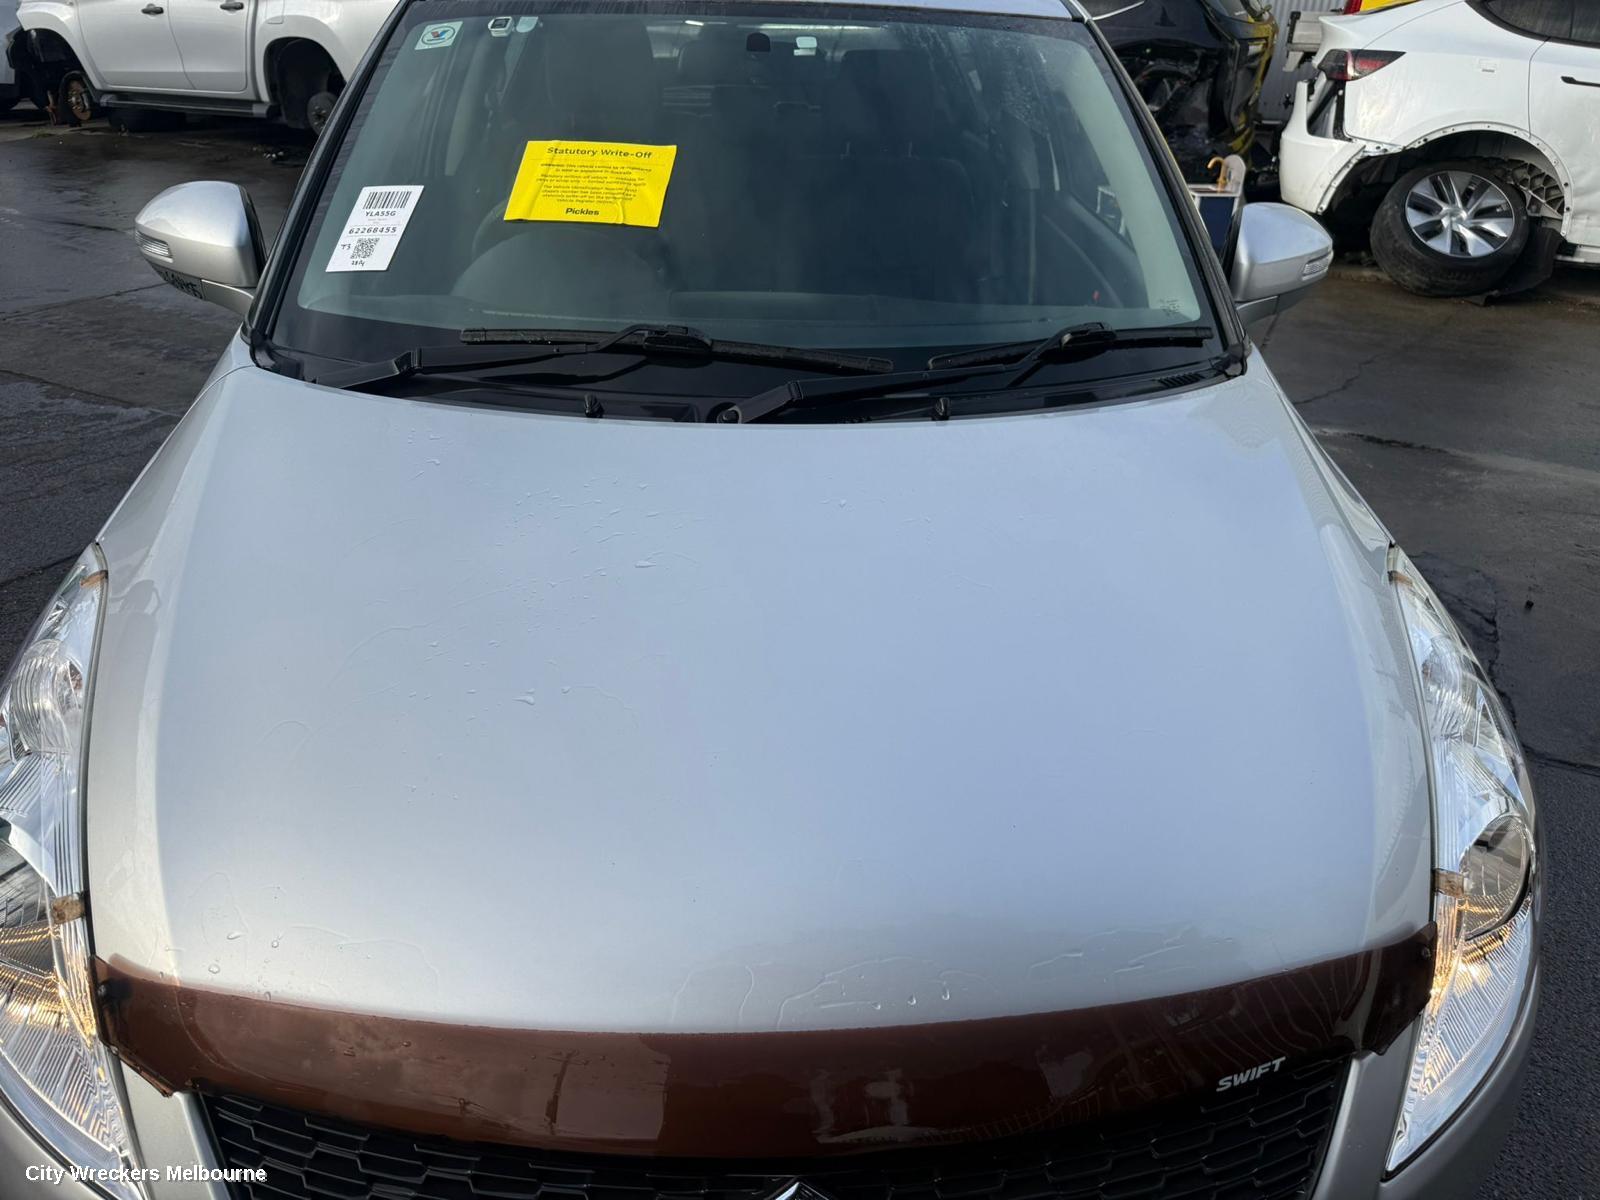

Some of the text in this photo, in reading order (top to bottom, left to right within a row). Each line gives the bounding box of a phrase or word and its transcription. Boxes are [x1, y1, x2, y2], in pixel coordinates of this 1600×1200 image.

[547, 146, 653, 159] Statutory Write-Off
[565, 207, 600, 216] Pickles
[348, 226, 397, 235] 62268455
[1215, 1056, 1287, 1092] SWIFT
